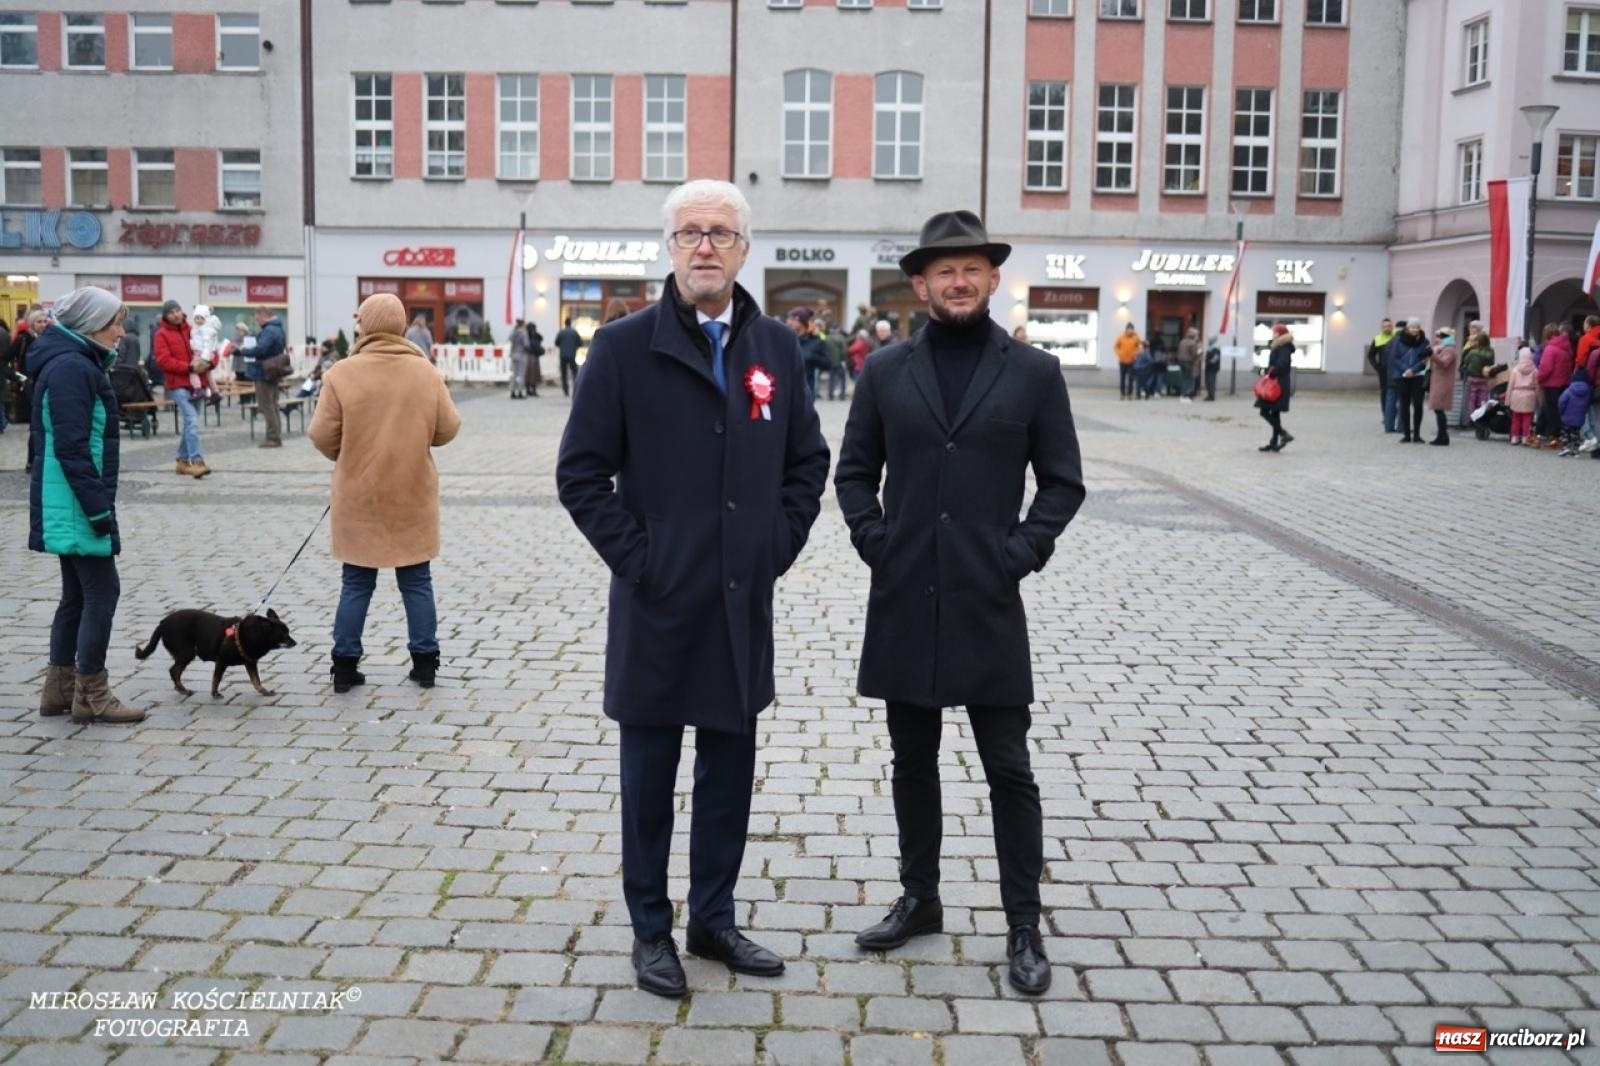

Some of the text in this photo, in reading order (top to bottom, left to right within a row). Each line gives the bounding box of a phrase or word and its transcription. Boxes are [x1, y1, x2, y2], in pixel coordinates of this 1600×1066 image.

[118, 219, 262, 250] zaprasza
[545, 236, 660, 261] JUBILER
[776, 248, 835, 262] BOLKO
[1131, 249, 1236, 271] JUBILER
